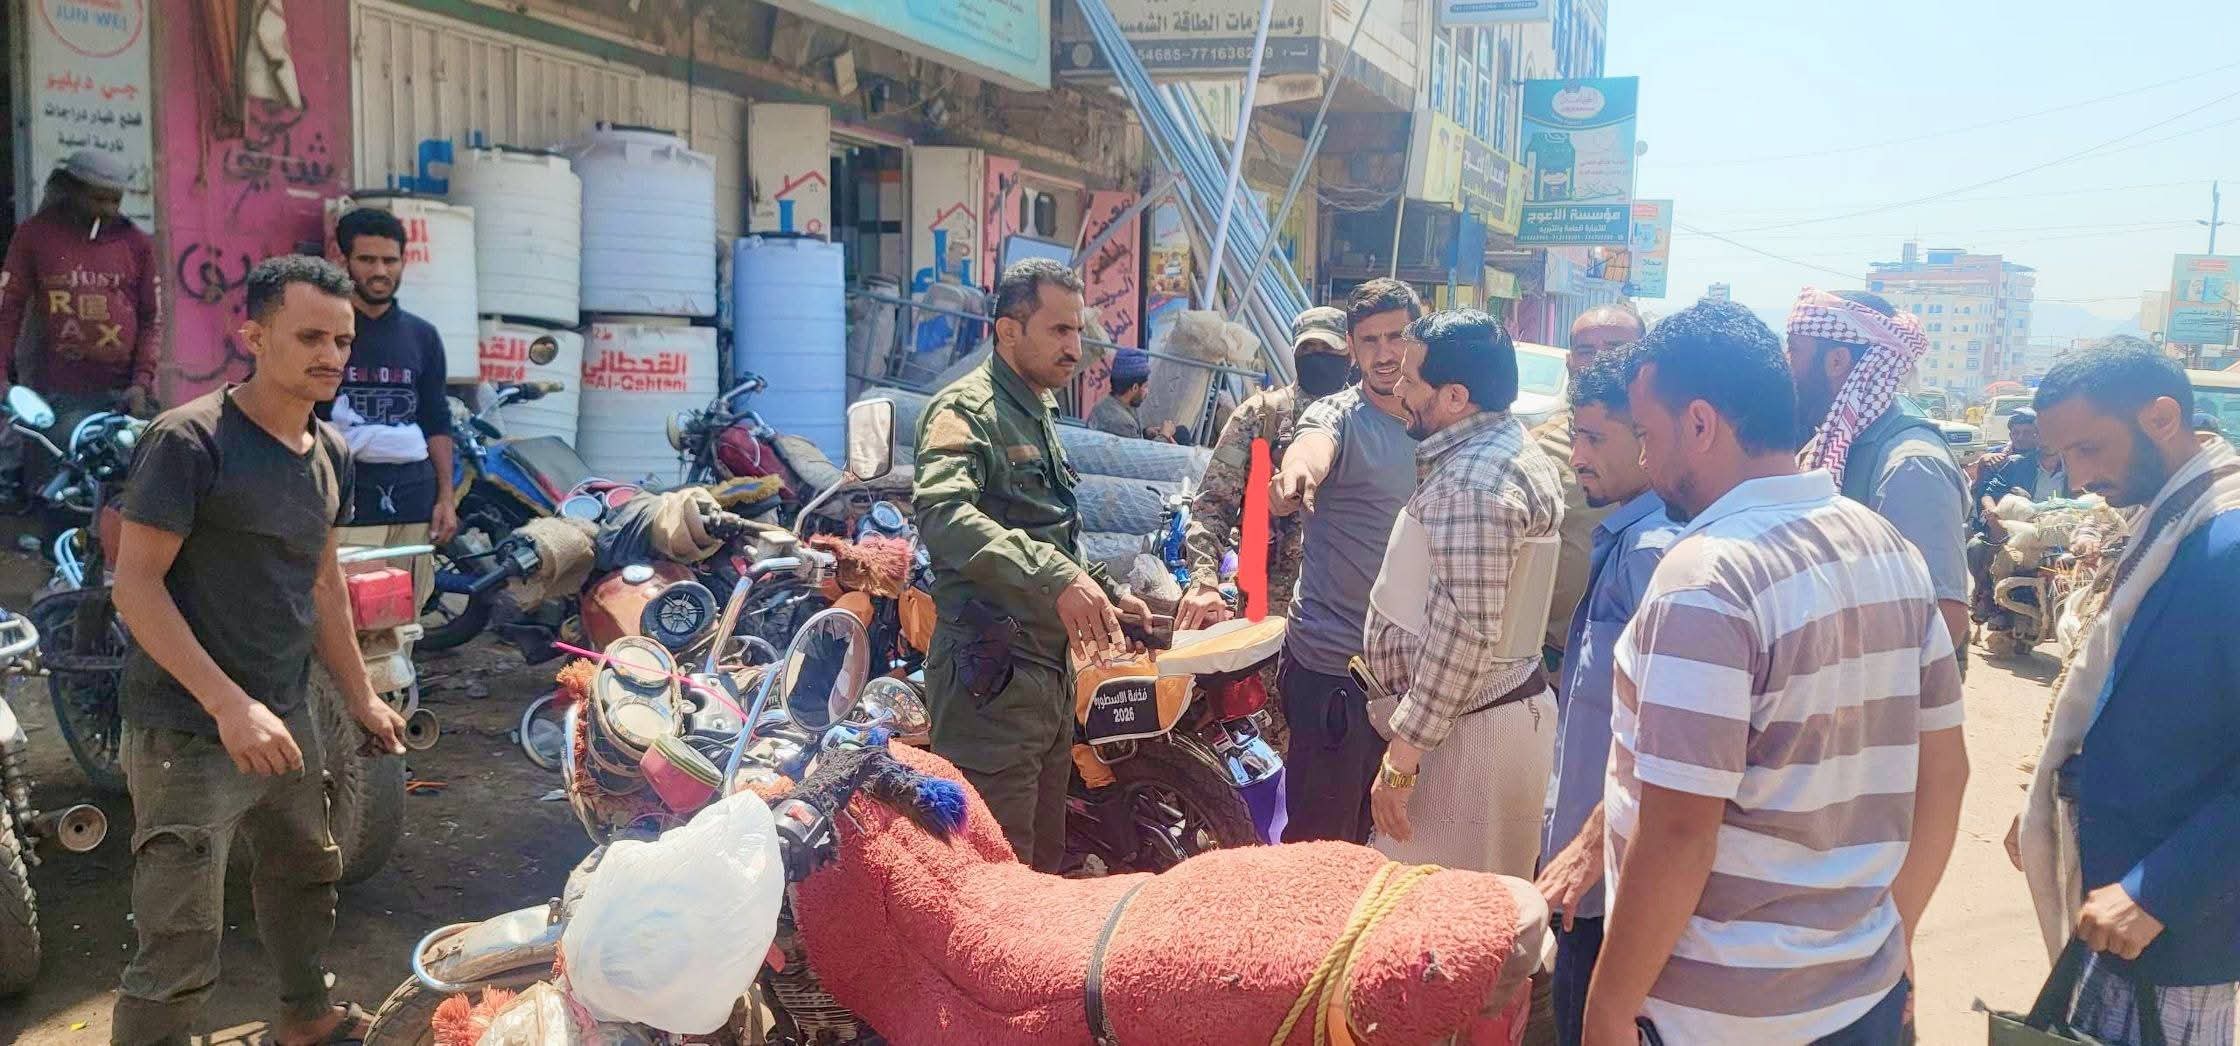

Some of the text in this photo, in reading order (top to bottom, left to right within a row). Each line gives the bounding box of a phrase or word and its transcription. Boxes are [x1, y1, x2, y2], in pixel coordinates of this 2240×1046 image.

[1173, 10, 1219, 33] الطاقة
[1569, 207, 1621, 224] مؤسسة
[582, 350, 687, 380] القحطاني
[1113, 706, 1135, 723] 2026
